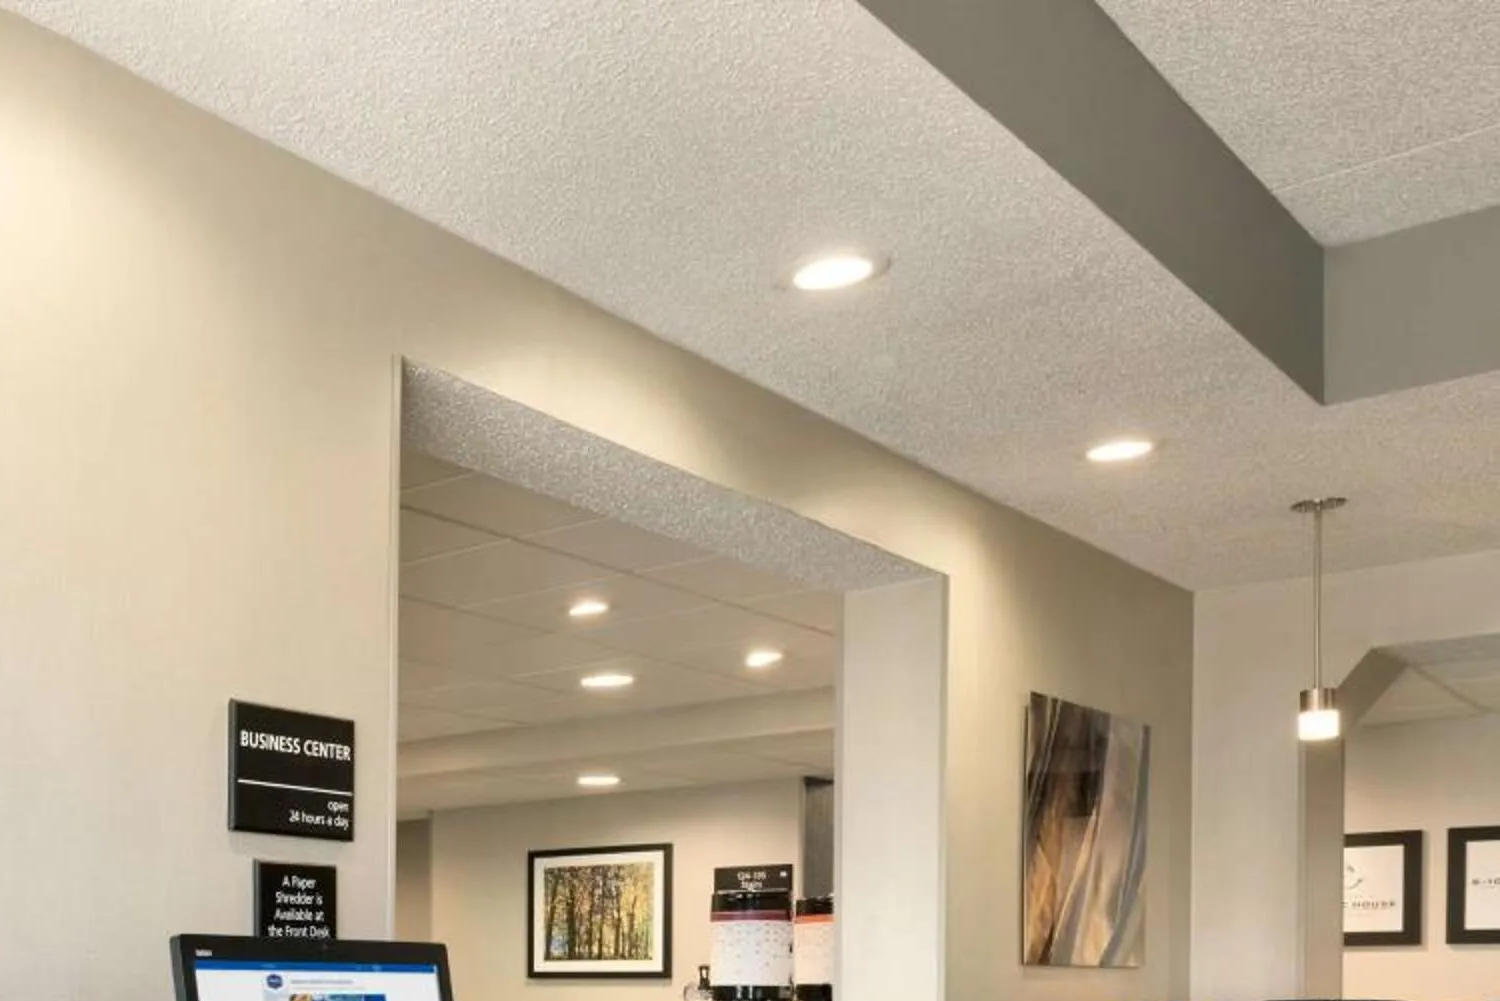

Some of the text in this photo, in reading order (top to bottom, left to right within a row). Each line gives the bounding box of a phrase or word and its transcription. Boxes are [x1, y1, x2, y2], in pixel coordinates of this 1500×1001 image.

[240, 729, 351, 761] BUSINESS CENTER
[327, 800, 349, 813] open
[289, 808, 350, 831] 24 hours a day
[281, 875, 317, 891] A Paper
[275, 891, 324, 906] Shredder is
[274, 907, 325, 923] Available at
[267, 923, 332, 939] the Front Desk
